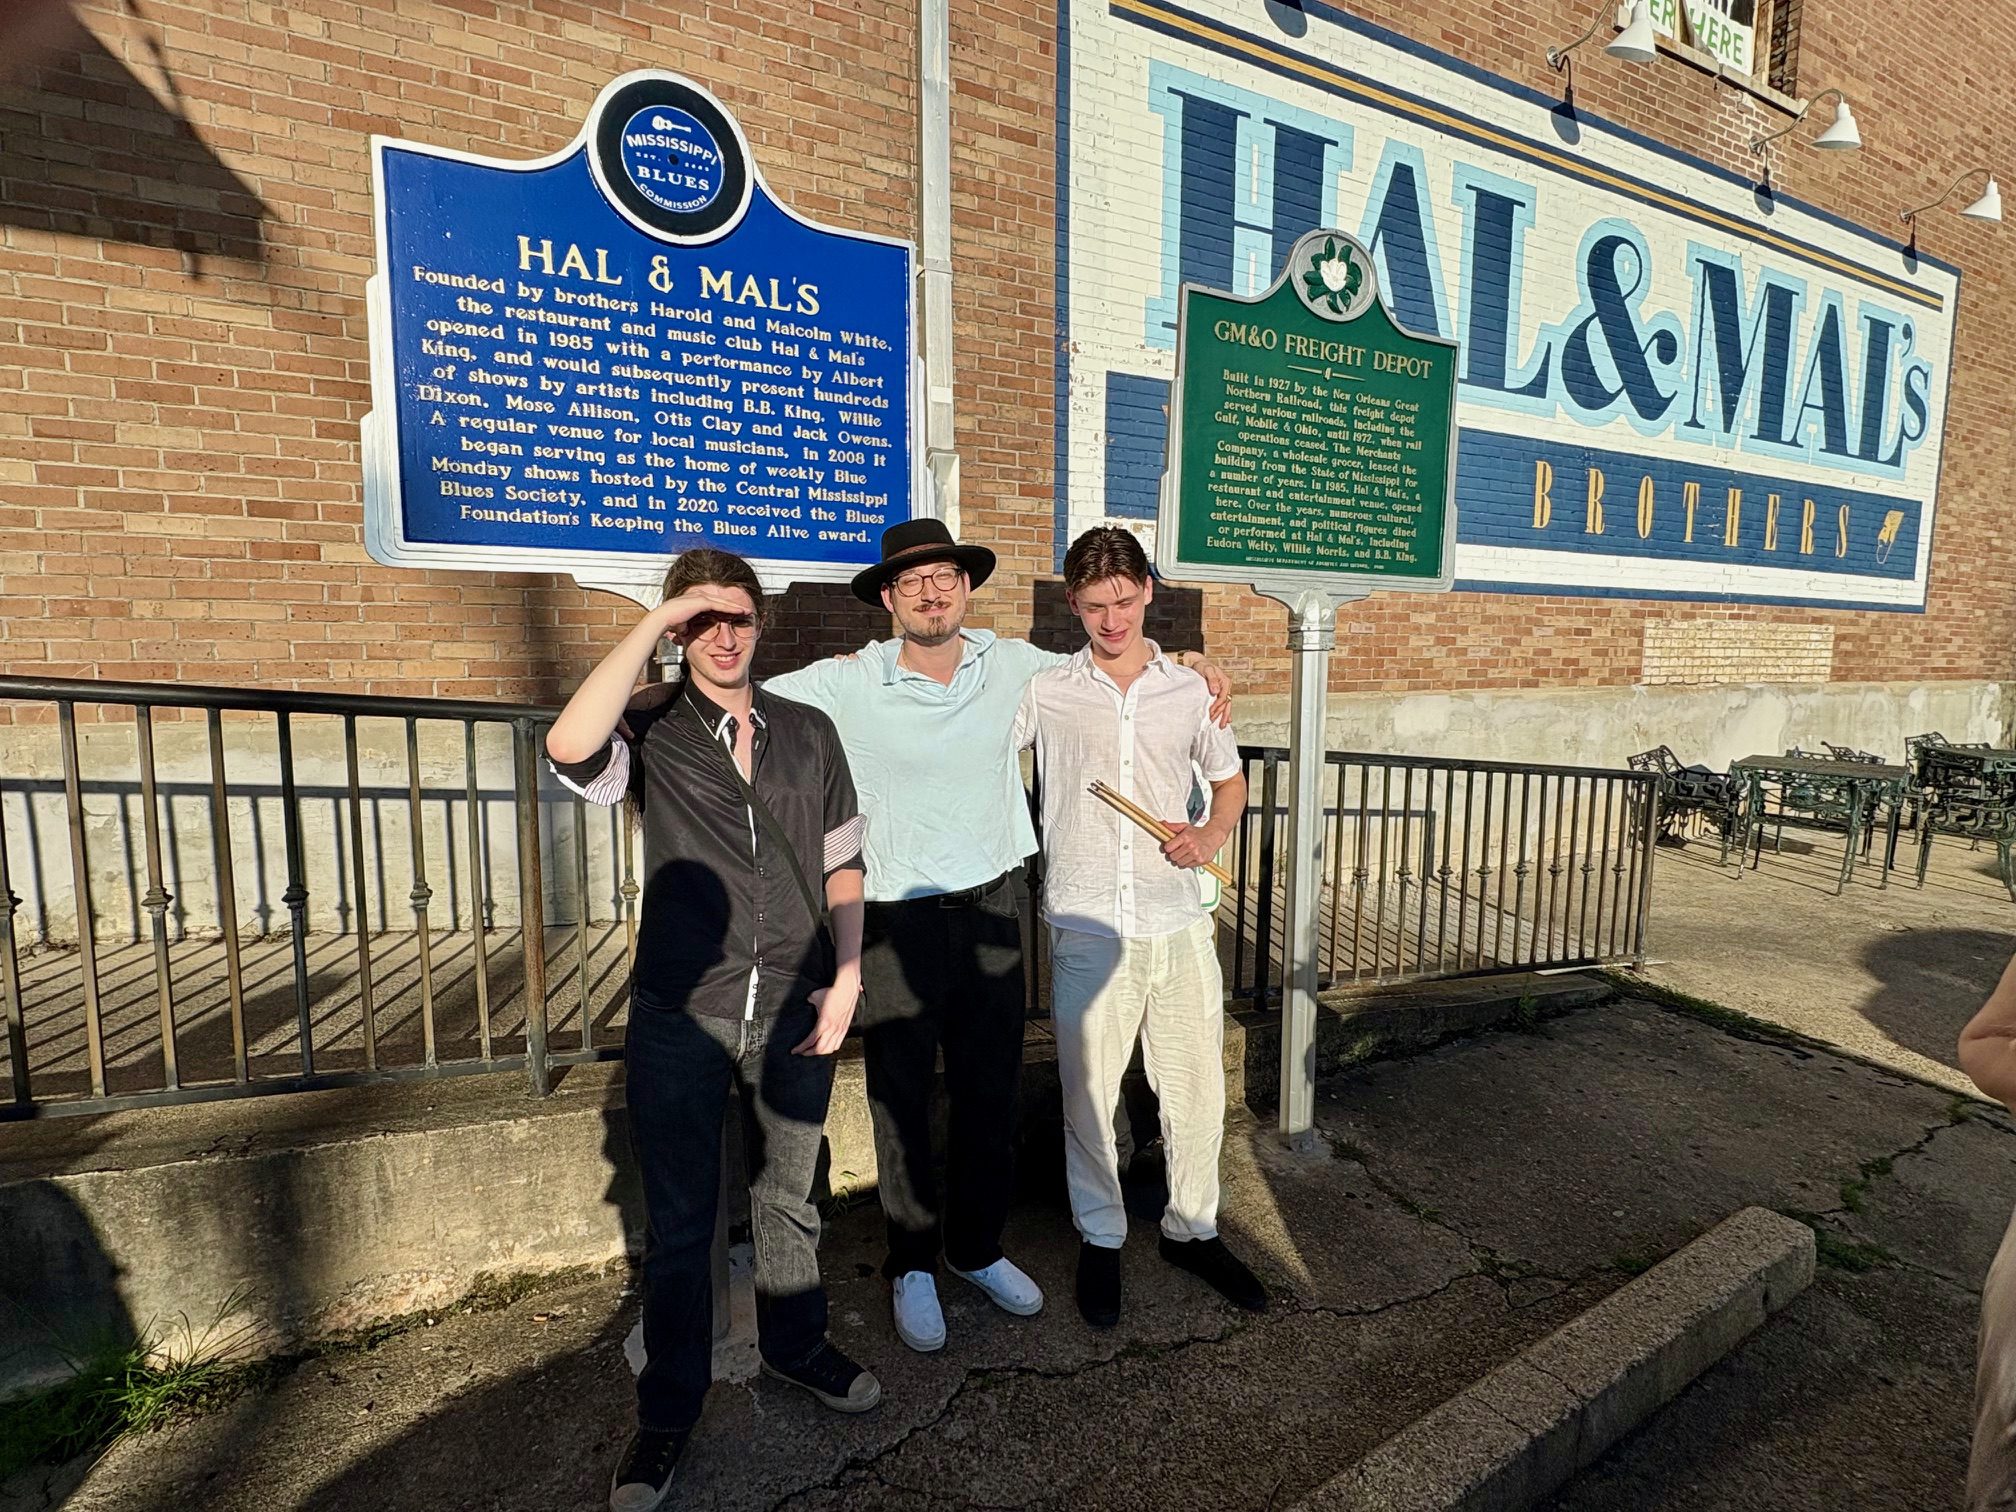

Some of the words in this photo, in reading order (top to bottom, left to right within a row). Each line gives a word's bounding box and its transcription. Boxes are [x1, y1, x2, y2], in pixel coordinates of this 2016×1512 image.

[1690, 8, 1744, 65] HERE
[625, 133, 718, 166] MISSISSIPPI
[636, 165, 710, 191] BLUES
[639, 183, 707, 210] COMMISSION
[516, 234, 622, 285] HAL
[647, 254, 673, 293] &
[698, 265, 819, 315] MAL'S
[1156, 82, 1554, 400] HAL
[1561, 234, 1678, 421] &
[412, 265, 505, 294] Founded
[516, 280, 544, 302] by
[553, 286, 638, 315] brothers
[650, 301, 712, 324] Harold
[722, 315, 755, 330] and
[766, 318, 831, 342] Malcolm
[839, 330, 891, 351] White,
[455, 295, 493, 315] the
[504, 306, 611, 331] restaurant
[620, 322, 656, 337] and
[666, 328, 716, 345] music
[724, 335, 762, 351] club
[771, 340, 799, 357] Hal
[808, 346, 819, 360] &
[425, 318, 505, 340] opened
[516, 326, 538, 344] in
[548, 331, 593, 350] 1985
[605, 341, 649, 358] with
[660, 349, 671, 361] a
[680, 352, 792, 376] performance
[801, 365, 822, 384] by
[831, 370, 883, 388] Albert
[1214, 320, 1277, 349] GM&O
[1284, 333, 1365, 366] FREIGHT
[1373, 350, 1432, 378] DEPOT
[432, 364, 456, 380] of
[467, 367, 528, 388] shows
[539, 374, 565, 396] by
[575, 382, 639, 400] artists
[650, 387, 733, 413] including
[743, 398, 775, 415] B.B.
[838, 410, 882, 427] Willie
[493, 350, 533, 366] and
[542, 356, 600, 374] would
[611, 363, 731, 392] subsequently
[741, 380, 804, 398] present
[813, 386, 888, 408] hundreds
[1225, 383, 1272, 402] Northern
[1352, 405, 1385, 421] freight
[1389, 411, 1416, 425] depot
[1268, 376, 1291, 391] 1927
[1293, 381, 1308, 396] by
[1394, 399, 1420, 412] Great
[505, 393, 555, 413] Mose
[653, 410, 691, 427] Otis
[701, 414, 742, 435] Clay
[751, 423, 782, 436] and
[792, 424, 828, 441] Jack
[837, 430, 891, 447] Owens.
[1223, 401, 1258, 414] served
[429, 409, 445, 425] A
[458, 415, 537, 434] regular
[546, 424, 604, 440] venue
[613, 427, 642, 443] for
[651, 431, 694, 448] local
[704, 439, 789, 458] musicians,
[802, 446, 819, 460] in
[827, 448, 865, 464] 2008
[873, 453, 886, 466] it
[460, 435, 523, 456] began
[532, 445, 605, 466] serving
[616, 453, 636, 464] as
[643, 451, 675, 468] the
[683, 454, 730, 472] home
[738, 461, 757, 474] of
[765, 465, 824, 484] weekly
[834, 468, 867, 484] Blue
[1237, 431, 1290, 446] operations
[1332, 442, 1352, 455] The
[431, 455, 512, 480] Monday
[523, 463, 580, 481] shows
[590, 468, 654, 487] hosted
[664, 474, 688, 494] by
[696, 477, 727, 493] the
[735, 480, 800, 498] Central
[807, 486, 887, 508] Mississippi
[440, 480, 494, 498] Blues
[602, 493, 638, 508] and
[647, 495, 666, 510] in
[676, 496, 719, 513] 2020
[727, 503, 801, 519] received
[809, 506, 837, 521] the
[845, 508, 884, 524] Blues
[1287, 491, 1356, 507] entertainment
[459, 504, 579, 525] Foundation's
[590, 512, 664, 534] Keeping
[672, 517, 703, 533] the
[712, 519, 757, 536] Blues
[766, 523, 809, 538] Alive
[817, 529, 871, 542] award.
[1233, 526, 1286, 540] performed
[1532, 460, 1850, 558] BROTHERS
